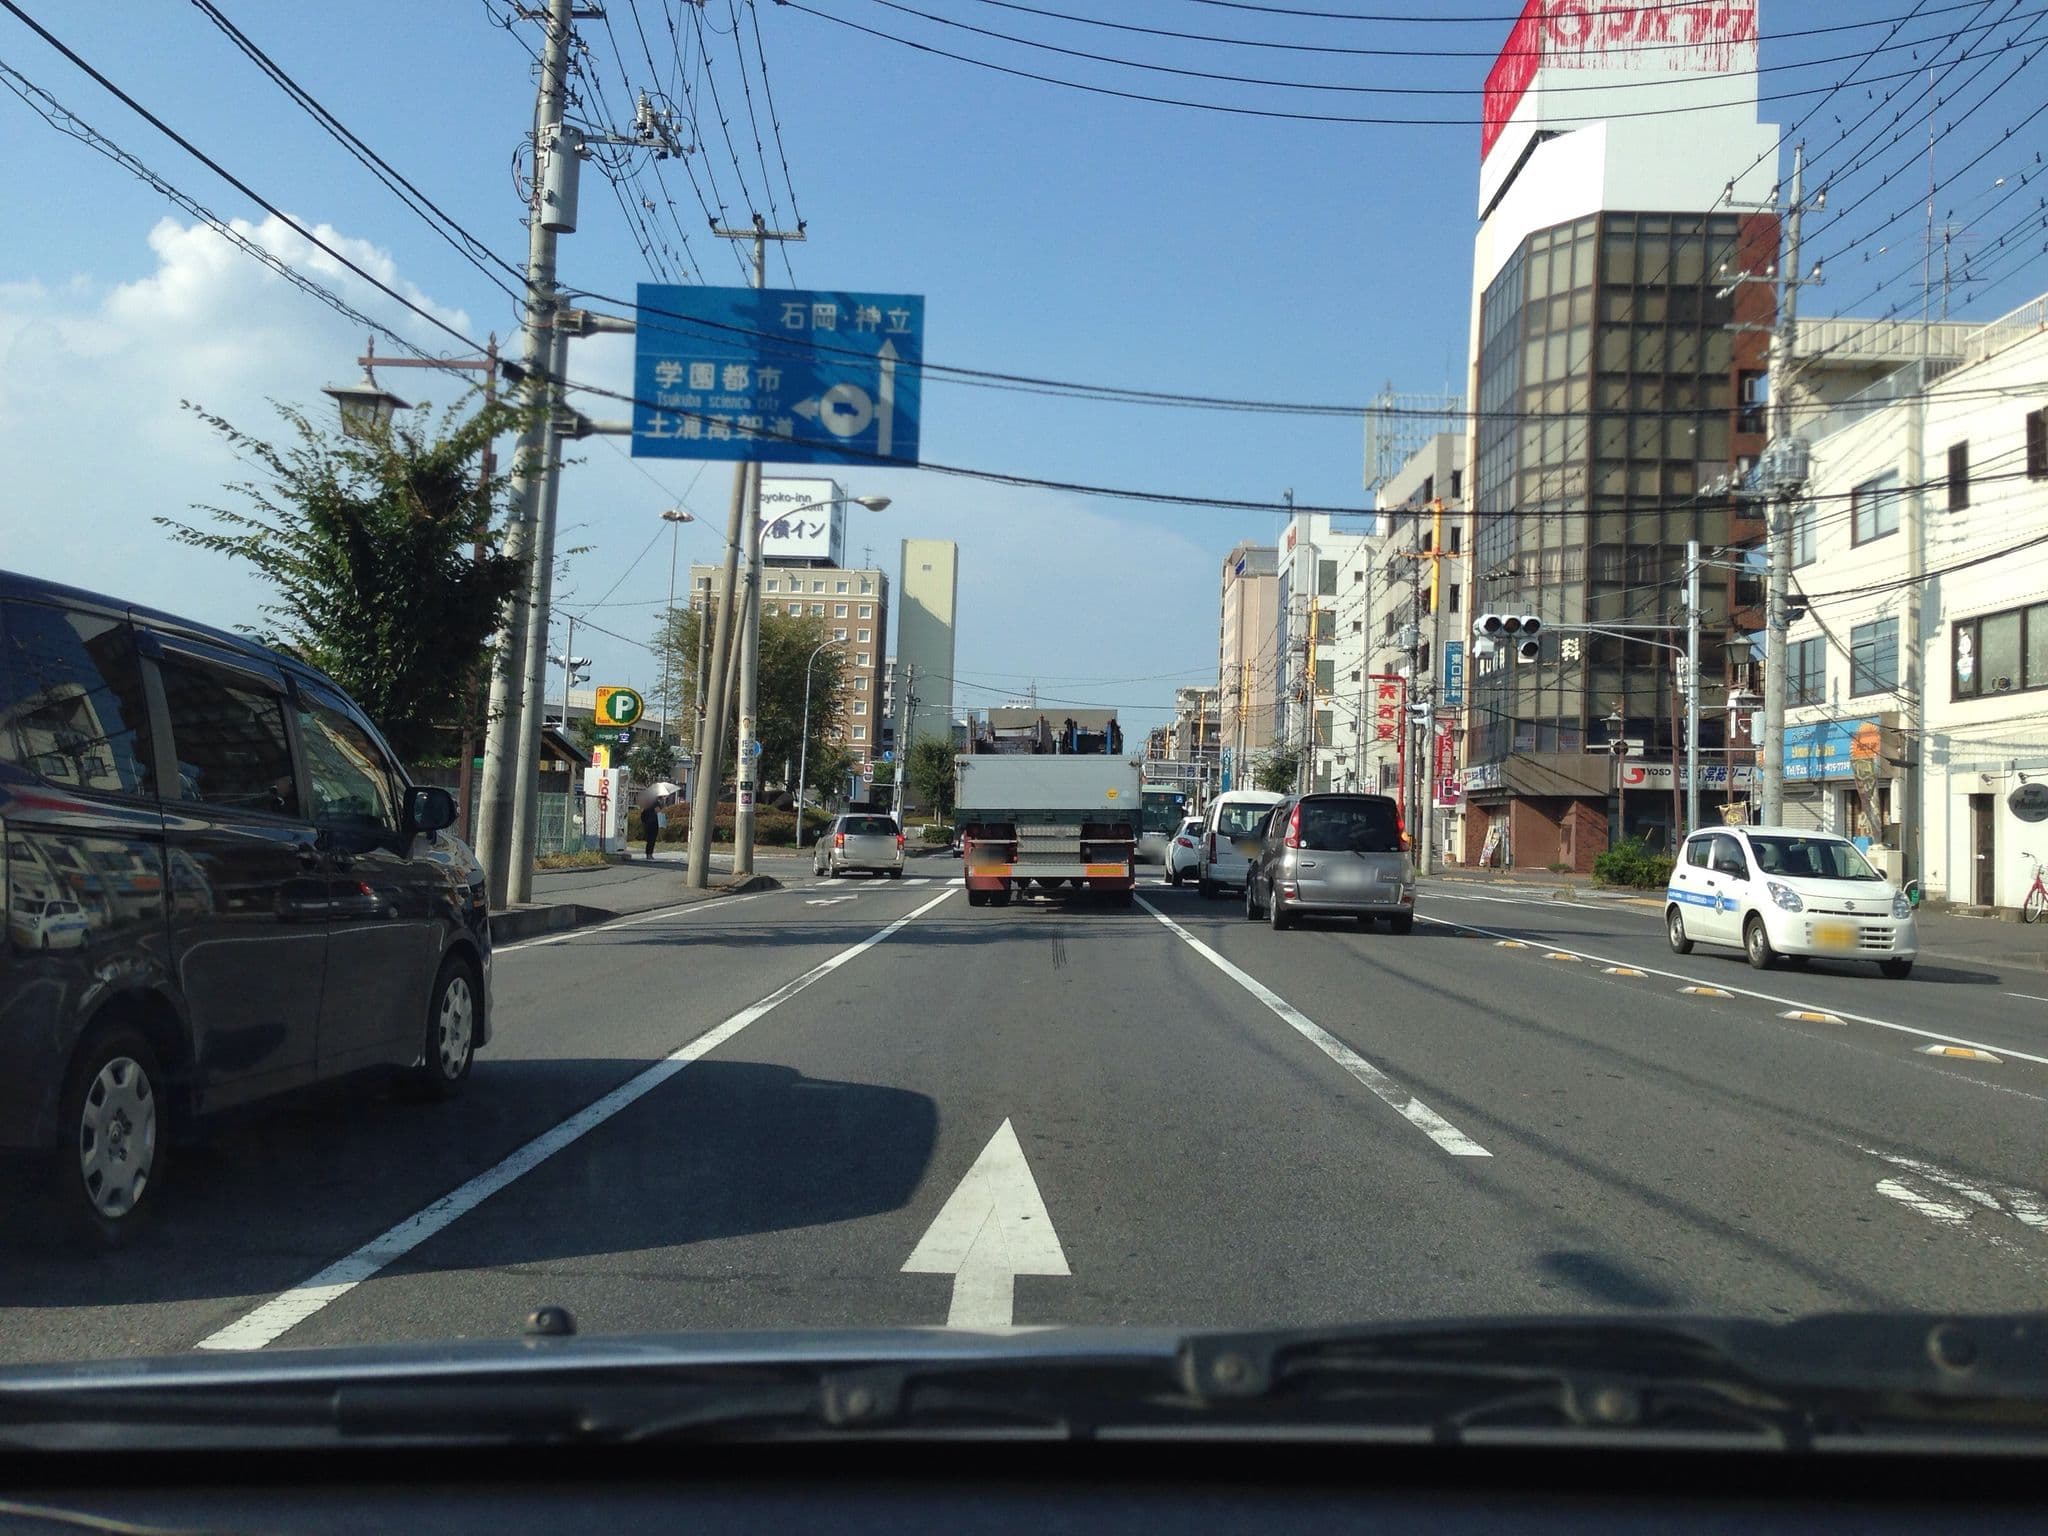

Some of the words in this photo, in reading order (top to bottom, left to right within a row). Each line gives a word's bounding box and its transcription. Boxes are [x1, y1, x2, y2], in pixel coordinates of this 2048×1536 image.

[781, 303, 912, 334] 石岡・神立
[655, 361, 783, 392] 学園都市
[760, 492, 812, 504] oyoko-inn
[615, 695, 634, 720] P
[1378, 684, 1396, 740] 美容室
